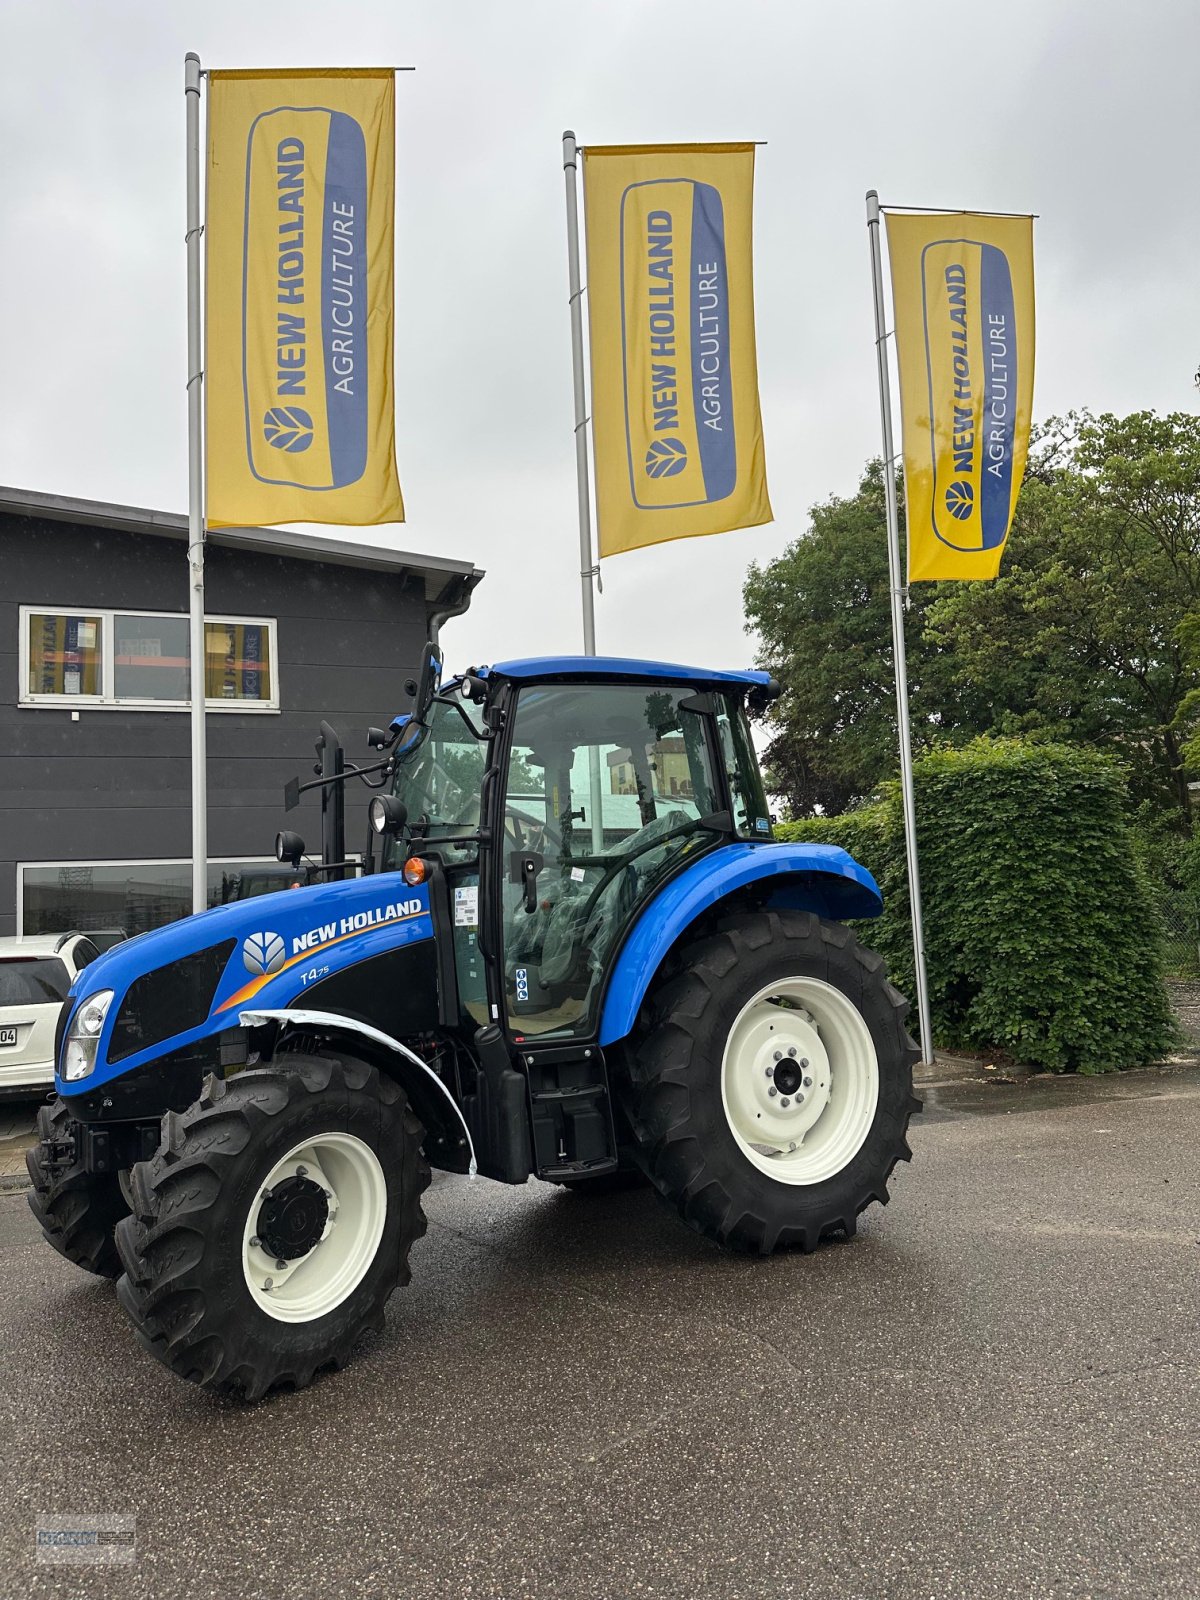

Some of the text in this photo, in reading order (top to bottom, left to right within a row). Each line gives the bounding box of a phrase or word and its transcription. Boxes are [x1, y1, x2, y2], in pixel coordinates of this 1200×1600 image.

[277, 137, 305, 396] NEW HOLLAND
[332, 201, 354, 395] AGRICULTURE
[648, 210, 679, 430] NEW HOLLAND
[698, 262, 722, 431] AGRICULTURE
[945, 264, 974, 472] NEW HOLLAND
[988, 314, 1008, 477] AGRICULTURE
[292, 921, 336, 954] NEW
[340, 898, 421, 934] HOLLAND
